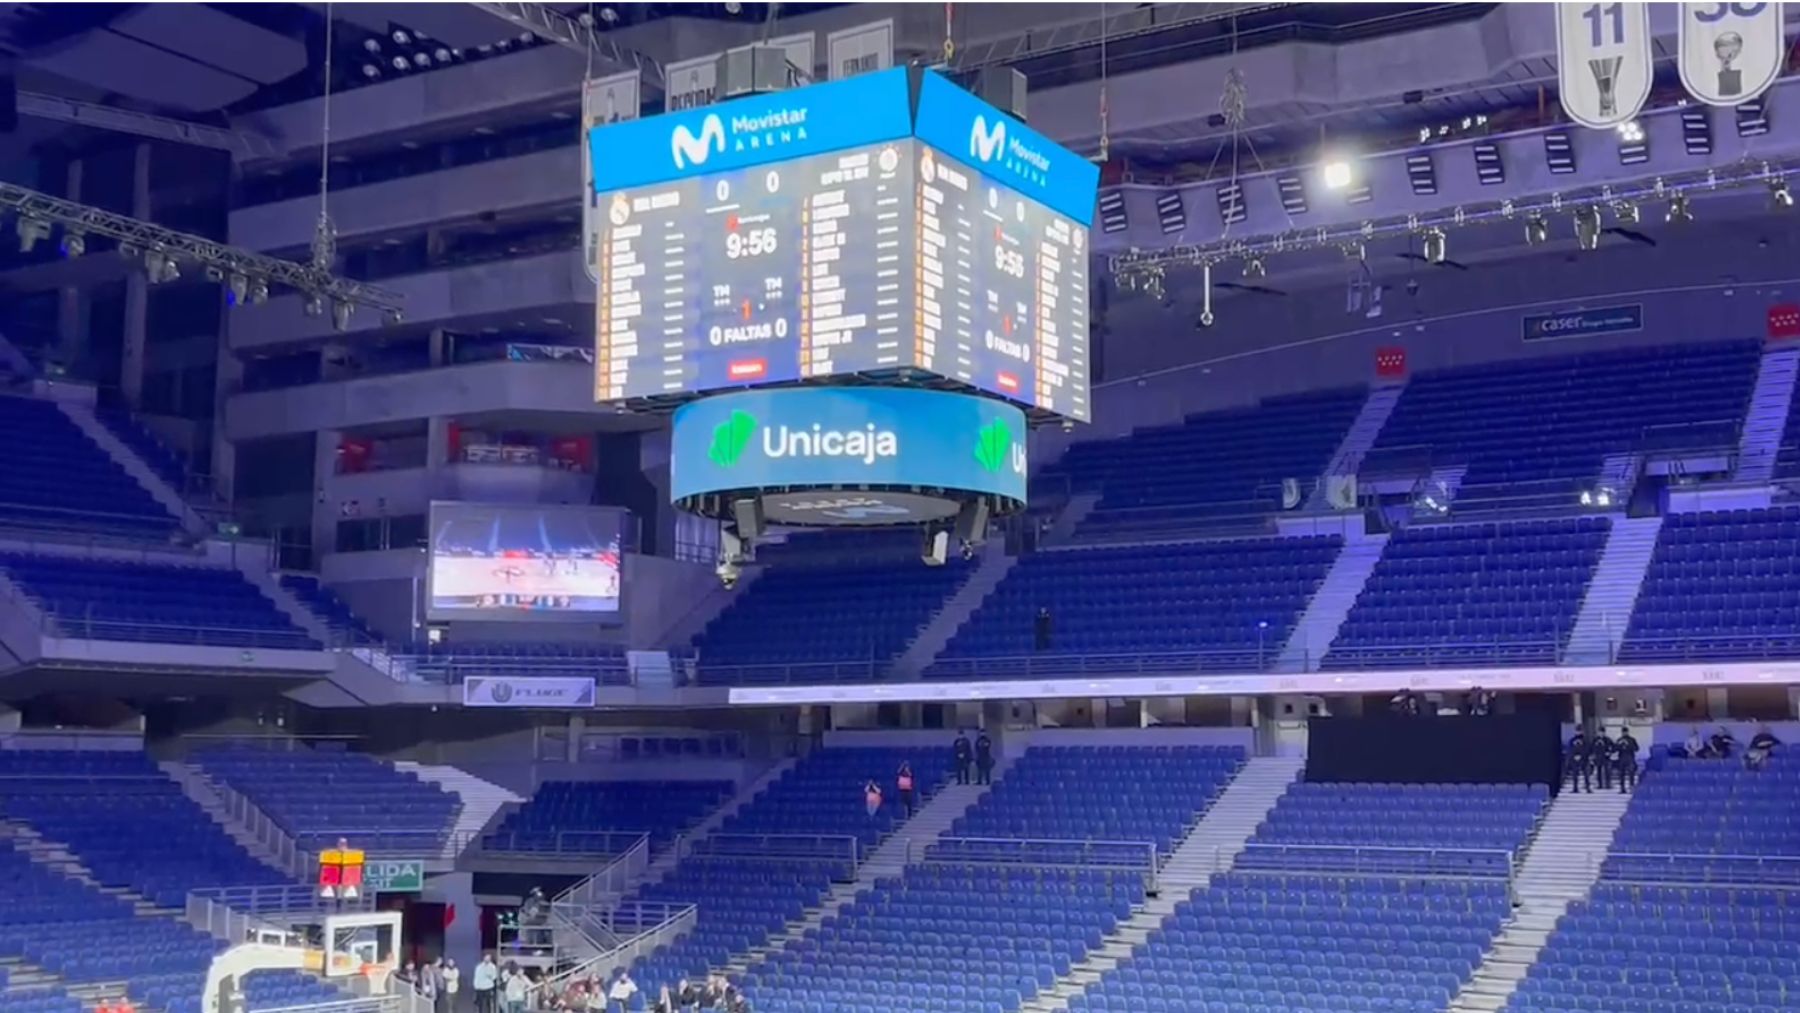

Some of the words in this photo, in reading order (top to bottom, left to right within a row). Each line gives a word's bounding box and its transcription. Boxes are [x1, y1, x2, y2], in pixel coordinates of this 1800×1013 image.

[1582, 3, 1624, 47] 11
[732, 107, 808, 134] Movistar
[735, 127, 807, 152] ARENA
[716, 179, 730, 201] 0
[766, 170, 780, 193] 0
[726, 228, 777, 259] 9:56
[710, 326, 722, 345] 0
[724, 324, 773, 343] FALTAS
[775, 318, 788, 338] 0
[1541, 316, 1583, 331] caser
[763, 424, 898, 465] Unicaja
[366, 864, 416, 877] LIDA
